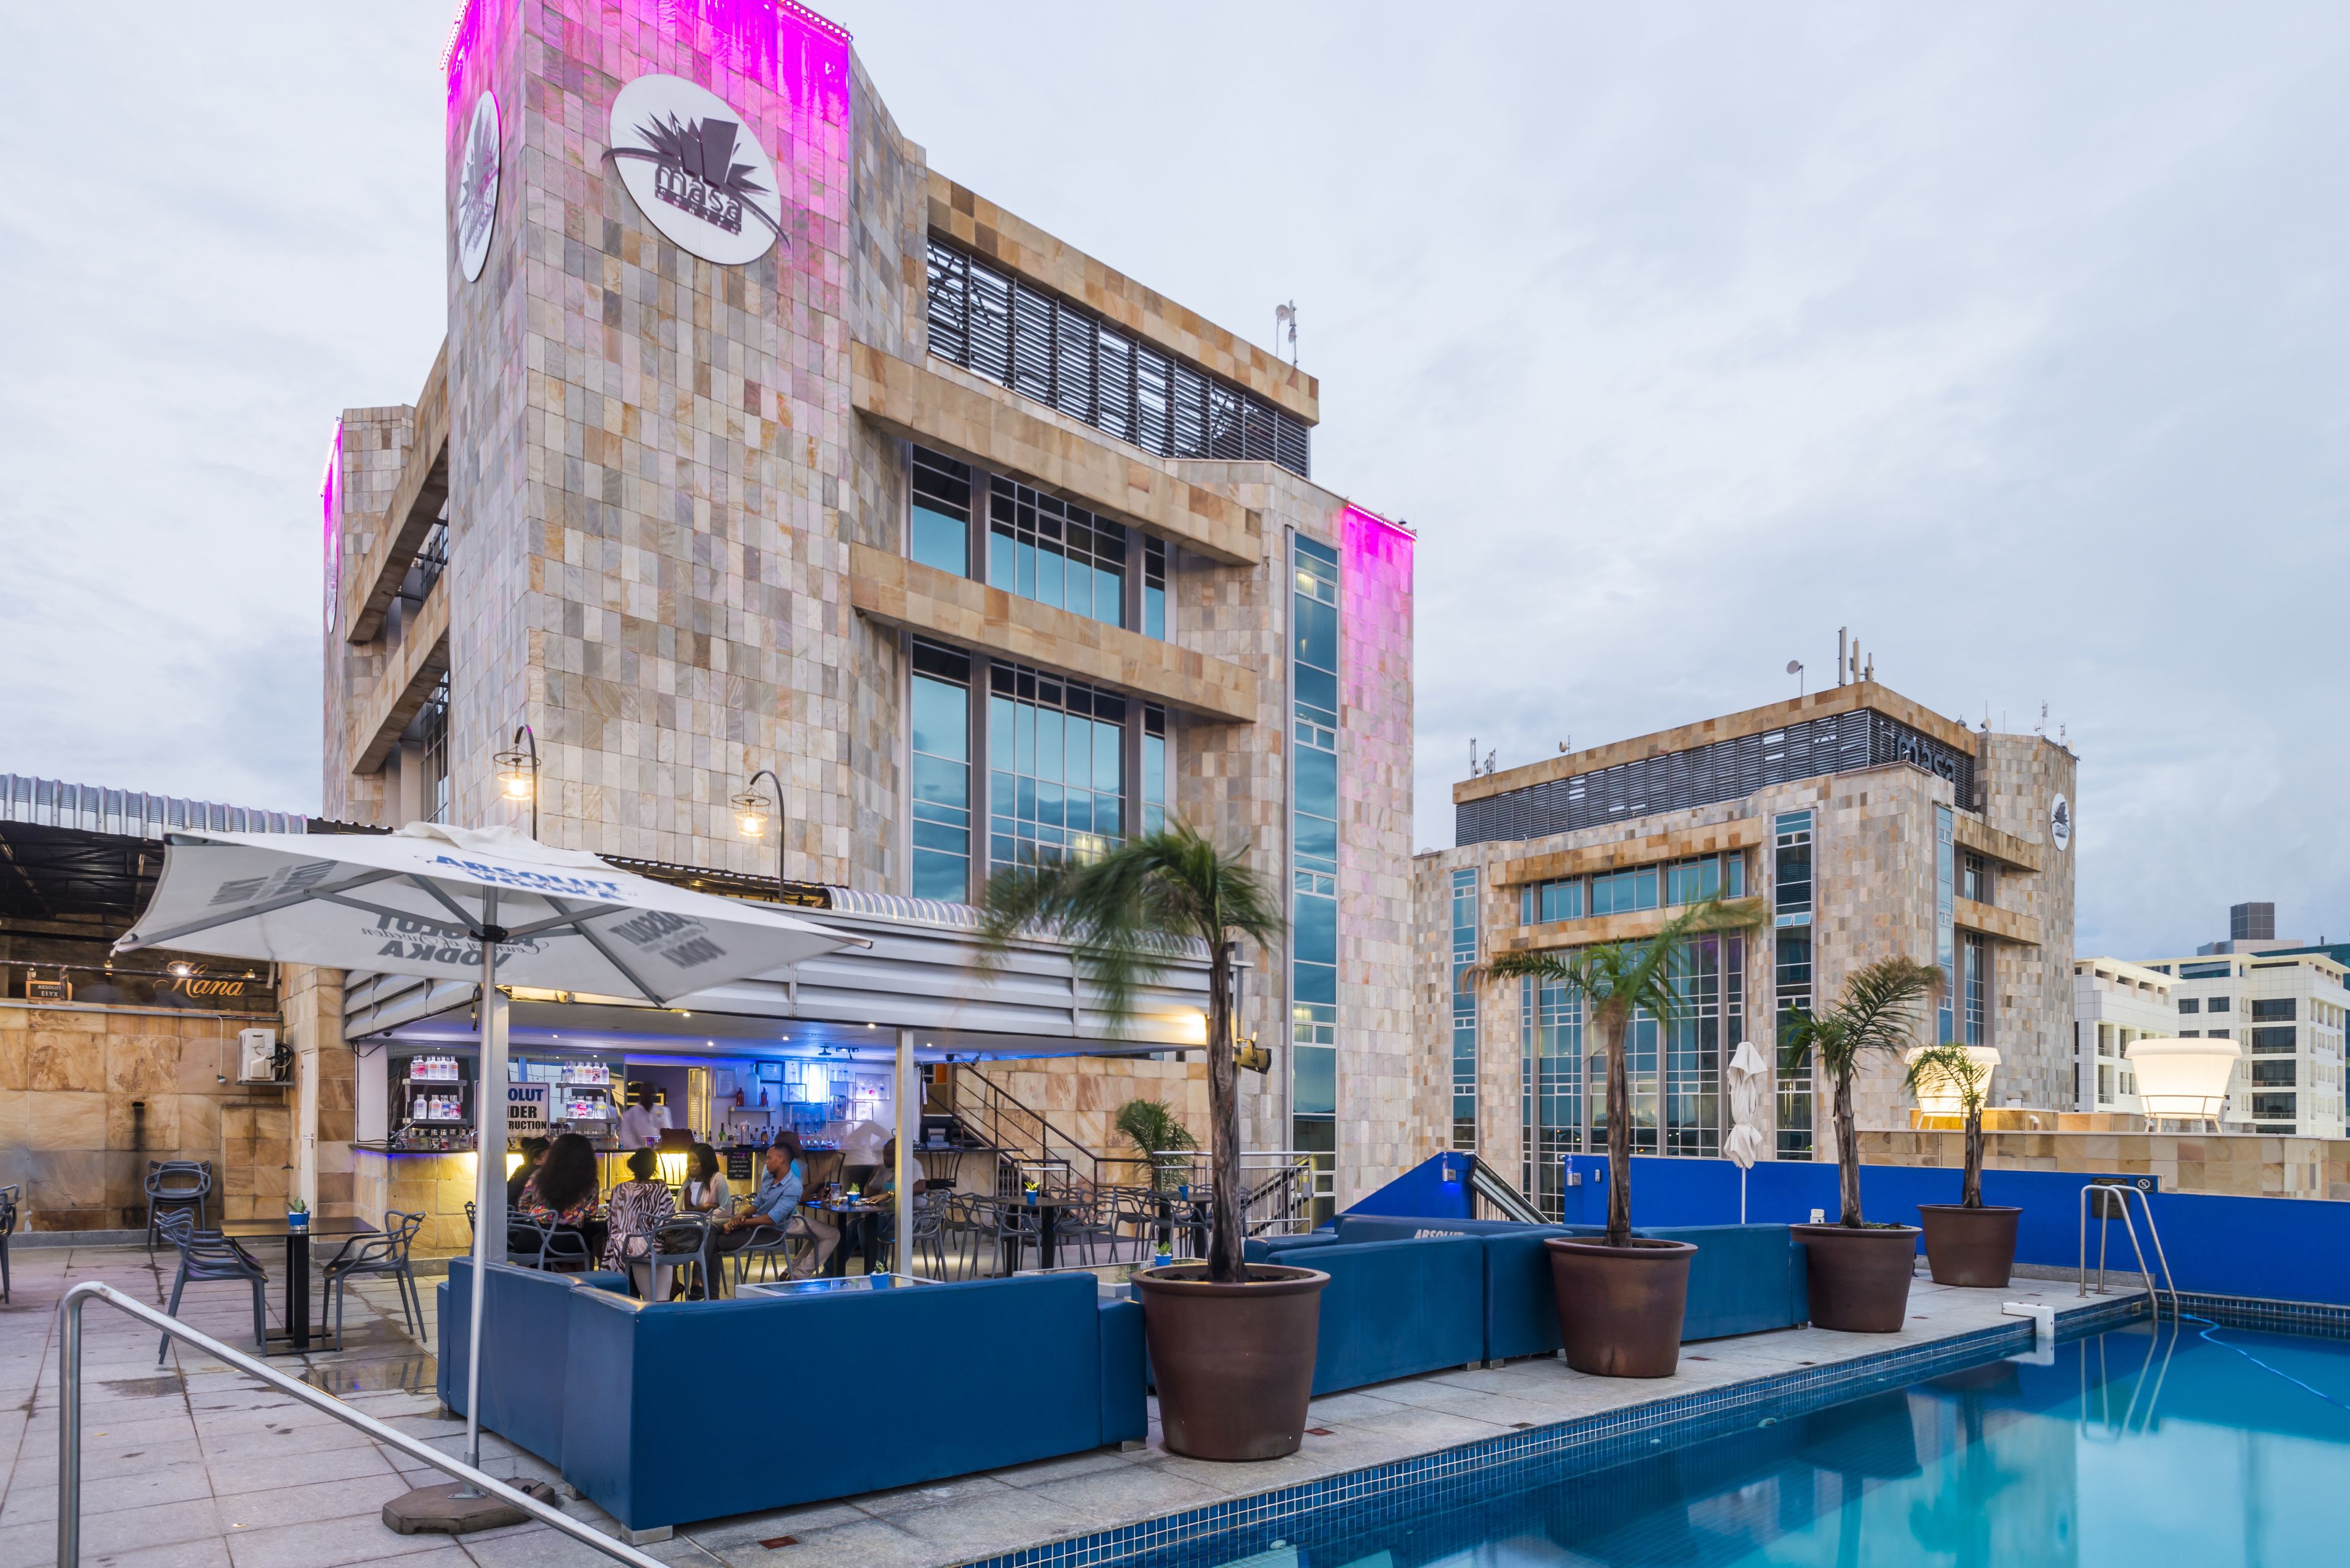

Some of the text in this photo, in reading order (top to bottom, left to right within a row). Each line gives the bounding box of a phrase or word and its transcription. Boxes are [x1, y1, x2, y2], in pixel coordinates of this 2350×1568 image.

[657, 162, 743, 223] masa
[436, 855, 623, 892] ABSOLUT
[508, 1088, 543, 1102] OLUT
